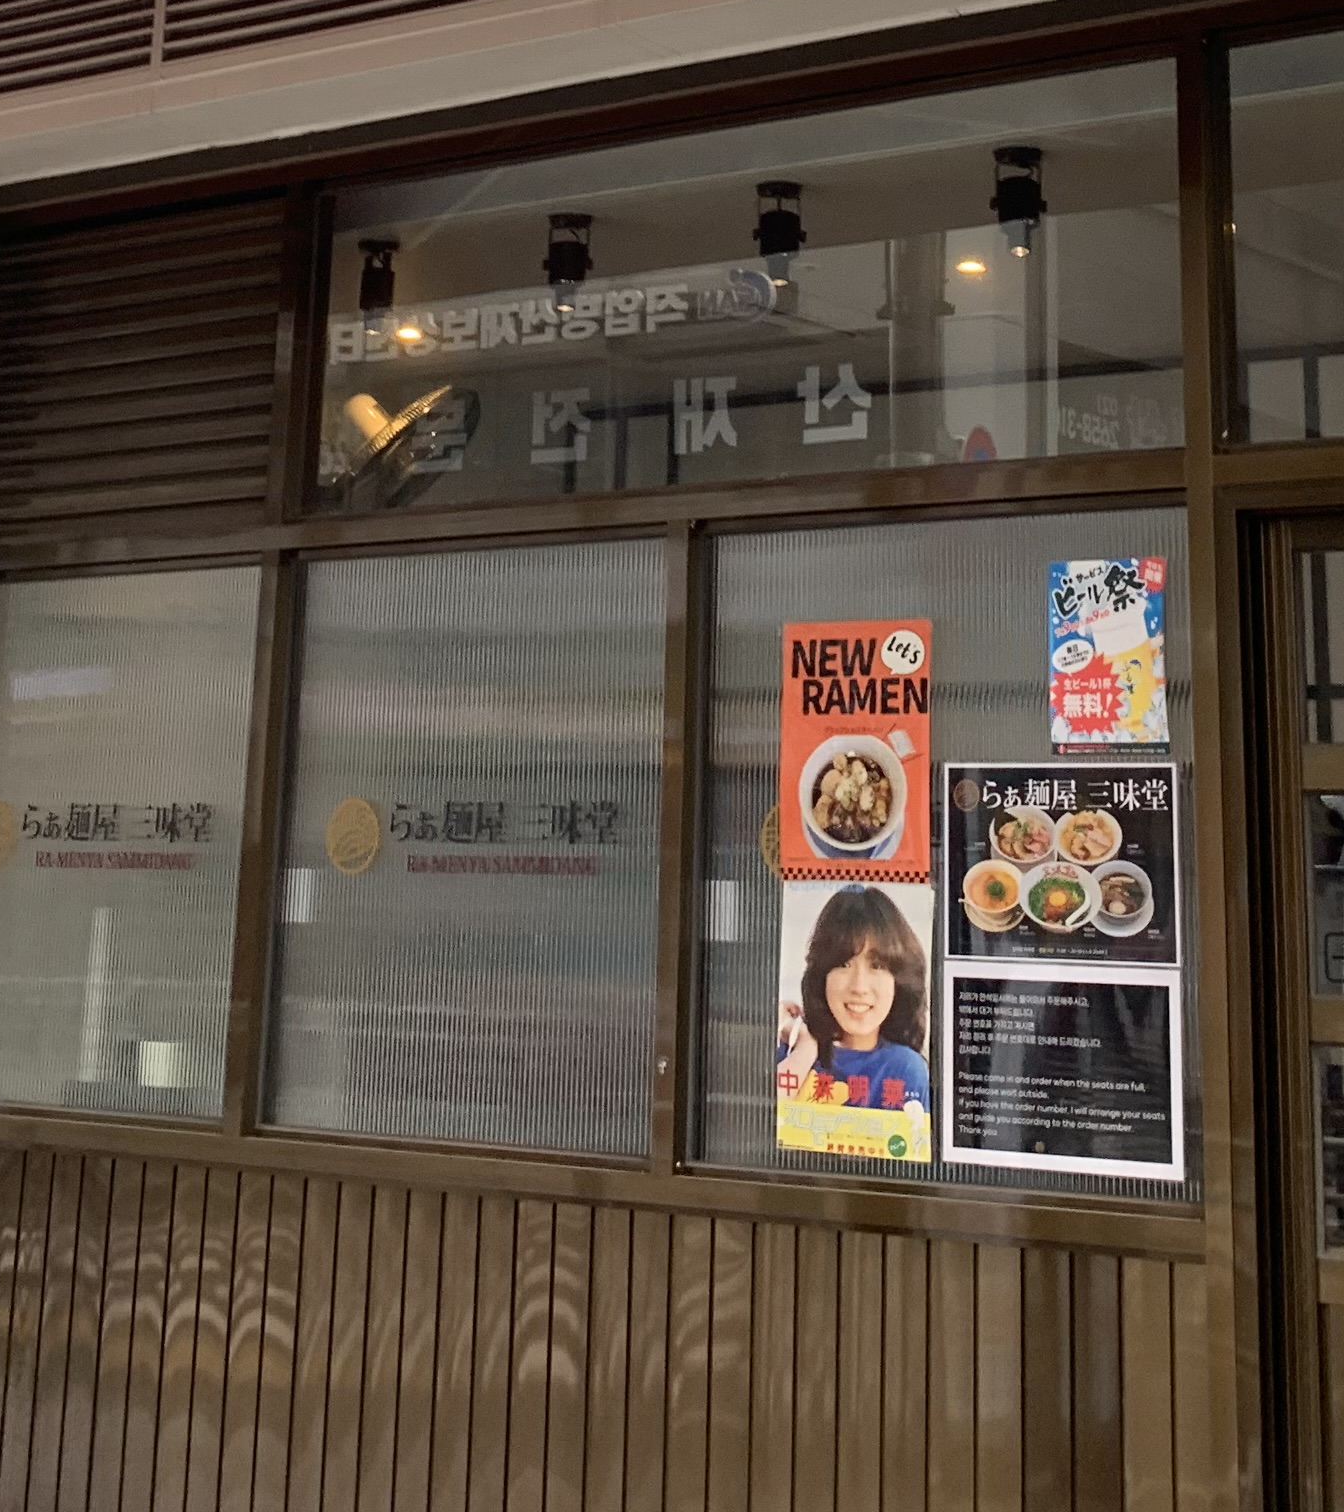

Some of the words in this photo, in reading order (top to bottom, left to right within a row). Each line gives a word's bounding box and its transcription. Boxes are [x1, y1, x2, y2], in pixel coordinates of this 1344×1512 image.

[791, 638, 876, 679] NEW
[886, 636, 922, 665] Let's
[802, 677, 929, 716] RAMEN
[1085, 778, 1169, 812] 三味堂
[958, 1071, 983, 1082] Please
[983, 1074, 1006, 1082] come
[1015, 1076, 1030, 1084] and
[1030, 1076, 1052, 1085] order
[1052, 1078, 1076, 1087] when
[1076, 1079, 1090, 1088] the
[1091, 1080, 1114, 1089] seats
[1115, 1081, 1130, 1090] are
[958, 1086, 973, 1094] and
[974, 1087, 999, 1096] please
[965, 1100, 979, 1109] you
[980, 1100, 999, 1108] have
[1000, 1101, 1014, 1109] the
[1015, 1103, 1035, 1111] order
[1074, 1107, 1088, 1115] will
[1088, 1108, 1121, 1119] arrange
[1121, 1111, 1141, 1120] your
[1142, 1112, 1166, 1121] seats
[958, 1113, 974, 1121] and
[974, 1113, 996, 1123] guide
[996, 1116, 1011, 1124] you
[1011, 1117, 1051, 1128] according
[1051, 1119, 1061, 1127] to
[1062, 1120, 1076, 1128] the
[1076, 1121, 1098, 1130] order
[958, 1124, 981, 1134] Thank
